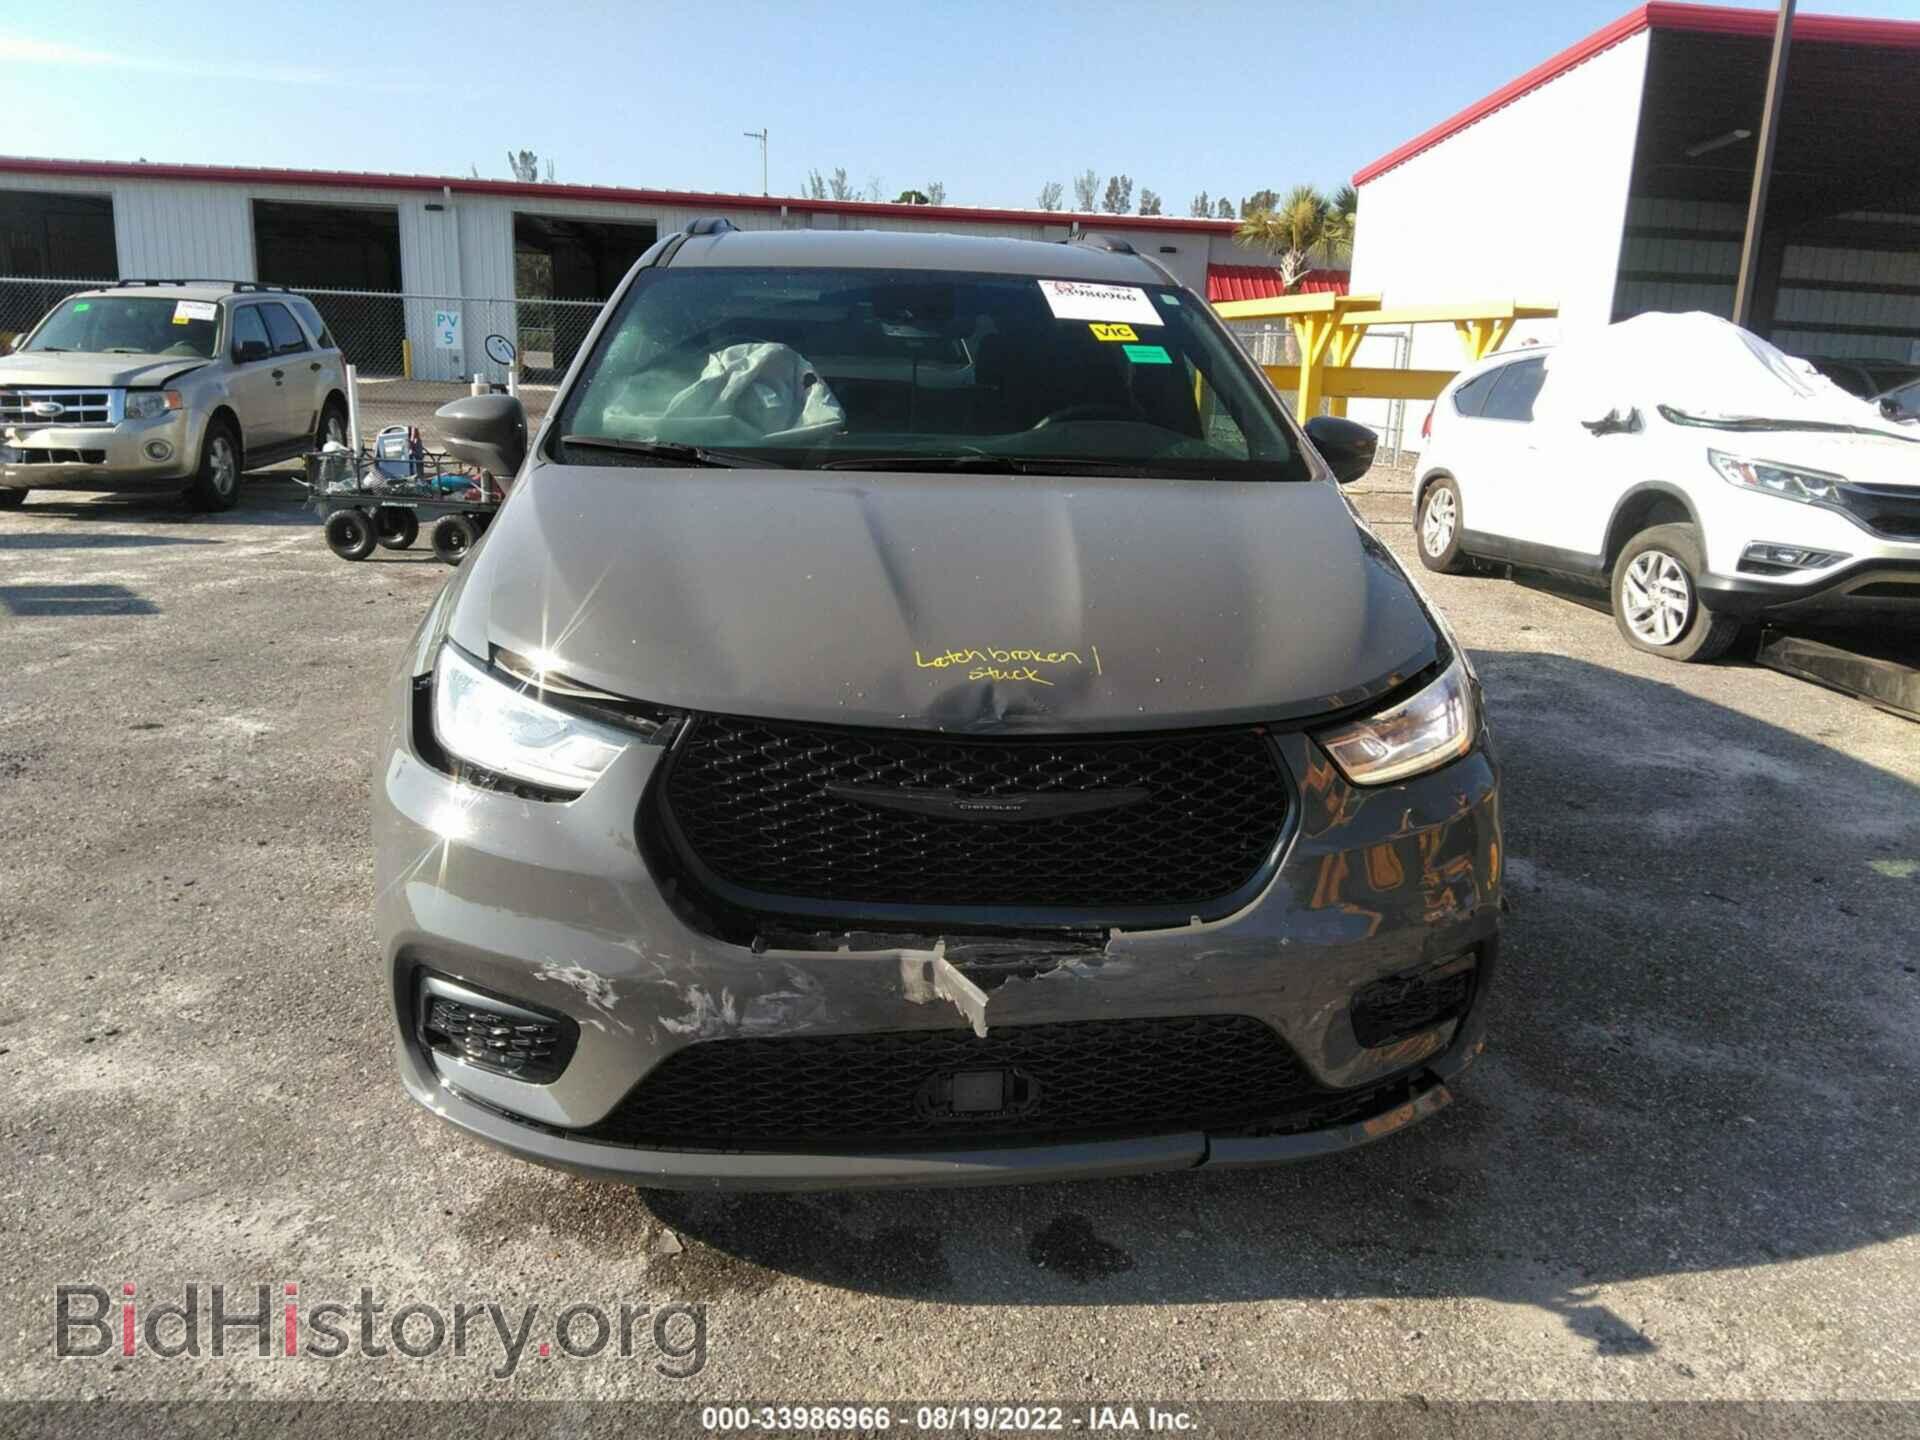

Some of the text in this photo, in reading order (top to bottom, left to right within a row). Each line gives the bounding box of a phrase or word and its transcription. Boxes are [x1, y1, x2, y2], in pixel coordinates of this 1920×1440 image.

[437, 314, 458, 327] PV
[444, 331, 454, 345] 5
[1095, 327, 1132, 337] VIC
[987, 647, 1082, 664] broken
[968, 666, 1055, 686] stuck
